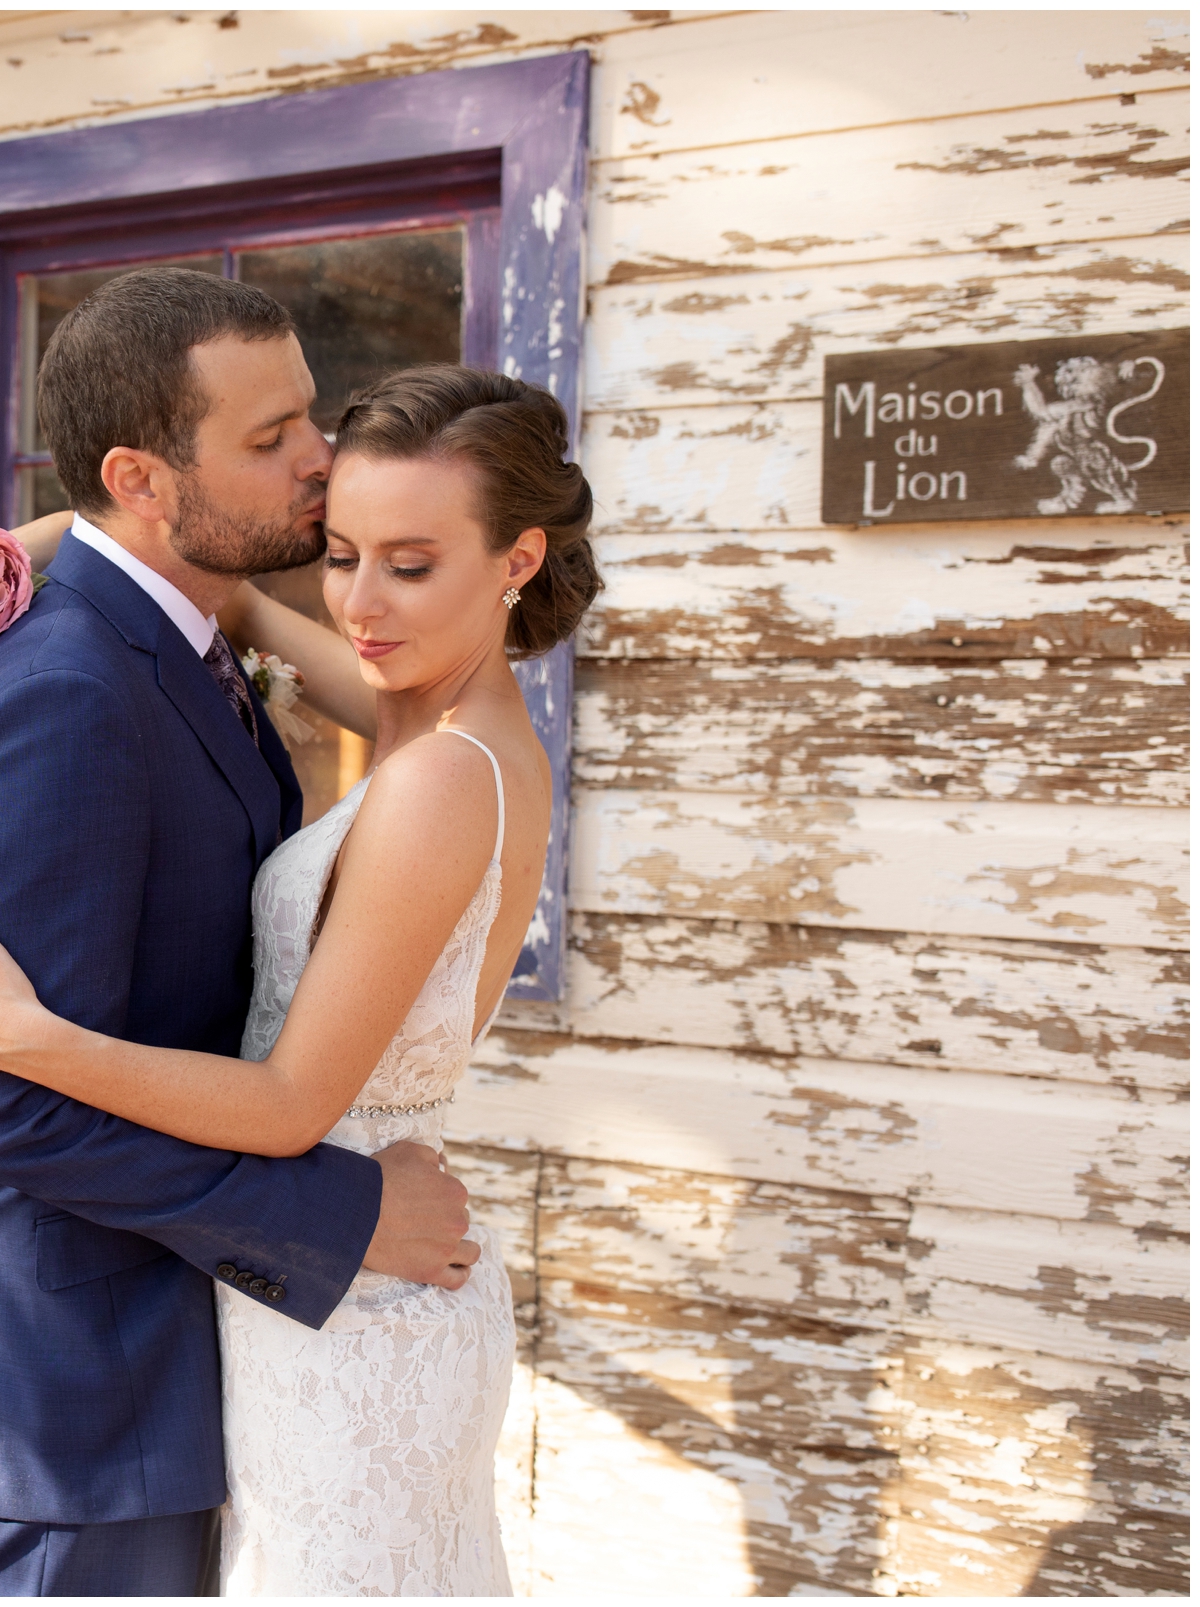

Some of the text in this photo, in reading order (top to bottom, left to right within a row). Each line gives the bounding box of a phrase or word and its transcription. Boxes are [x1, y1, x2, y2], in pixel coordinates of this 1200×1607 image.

[833, 382, 1004, 439] Maison
[894, 429, 938, 457] du
[863, 461, 968, 517] Lion
